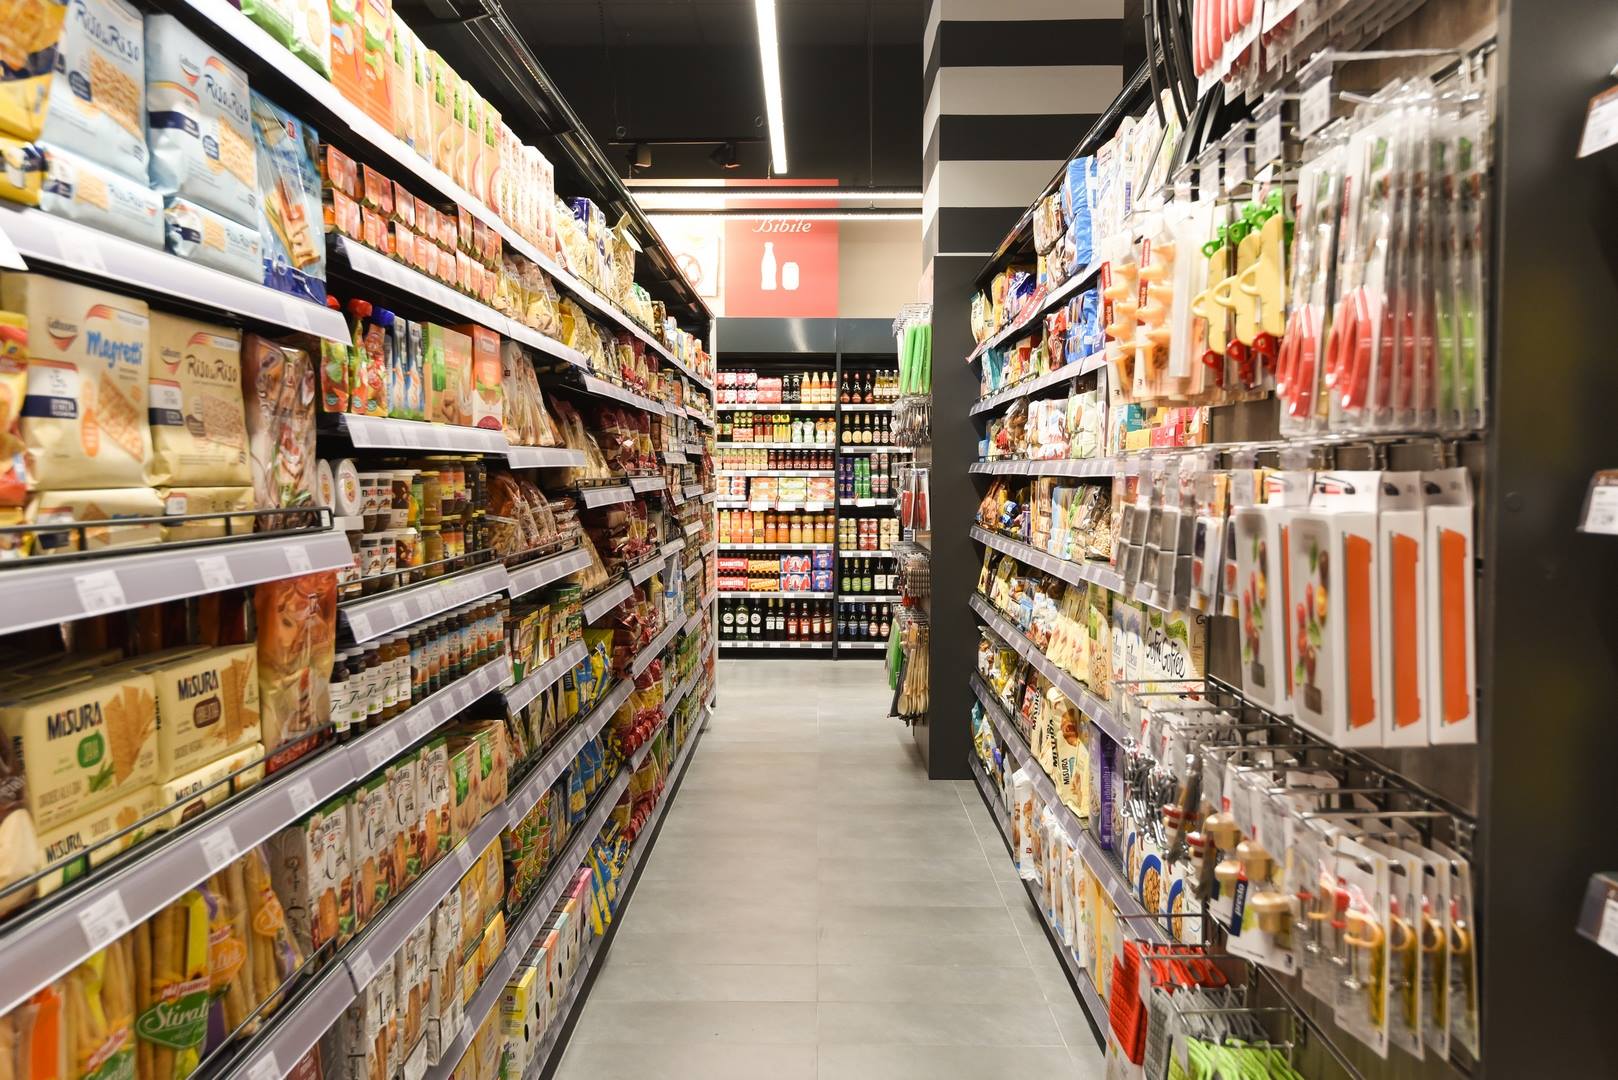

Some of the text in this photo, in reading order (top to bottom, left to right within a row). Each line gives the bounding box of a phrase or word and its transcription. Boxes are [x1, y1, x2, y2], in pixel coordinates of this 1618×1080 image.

[752, 217, 812, 233] Bibite
[86, 330, 143, 368] Magretti
[1234, 883, 1246, 916] presto
